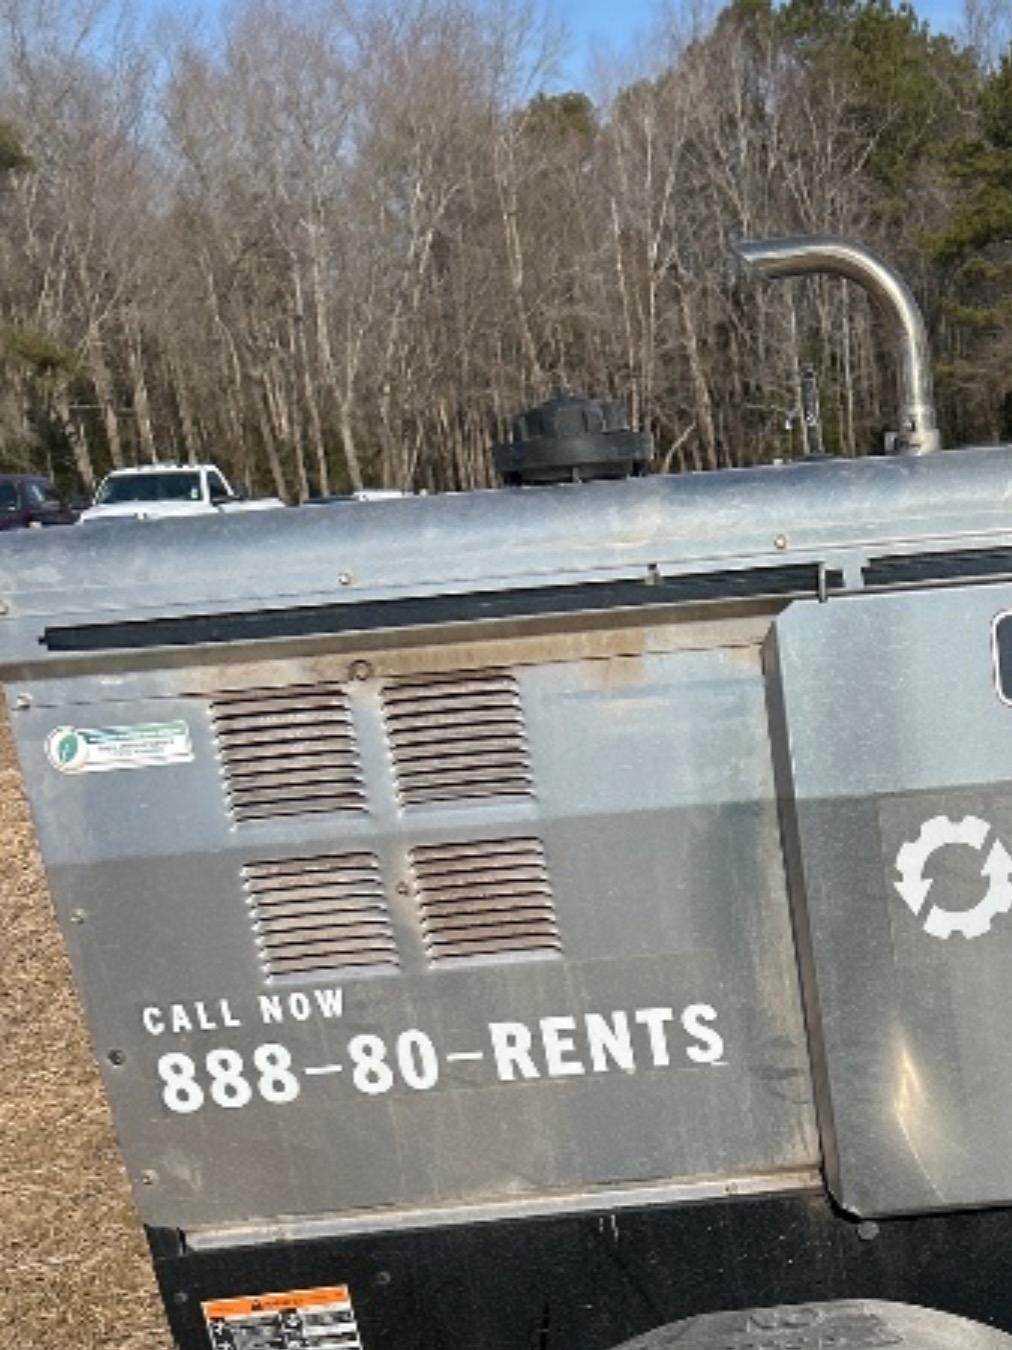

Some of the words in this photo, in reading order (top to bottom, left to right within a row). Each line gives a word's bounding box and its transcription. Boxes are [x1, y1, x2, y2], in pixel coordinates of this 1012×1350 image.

[142, 998, 242, 1036] CALL
[259, 988, 345, 1024] NOW
[157, 1003, 726, 1114] 888-80-RENTS
